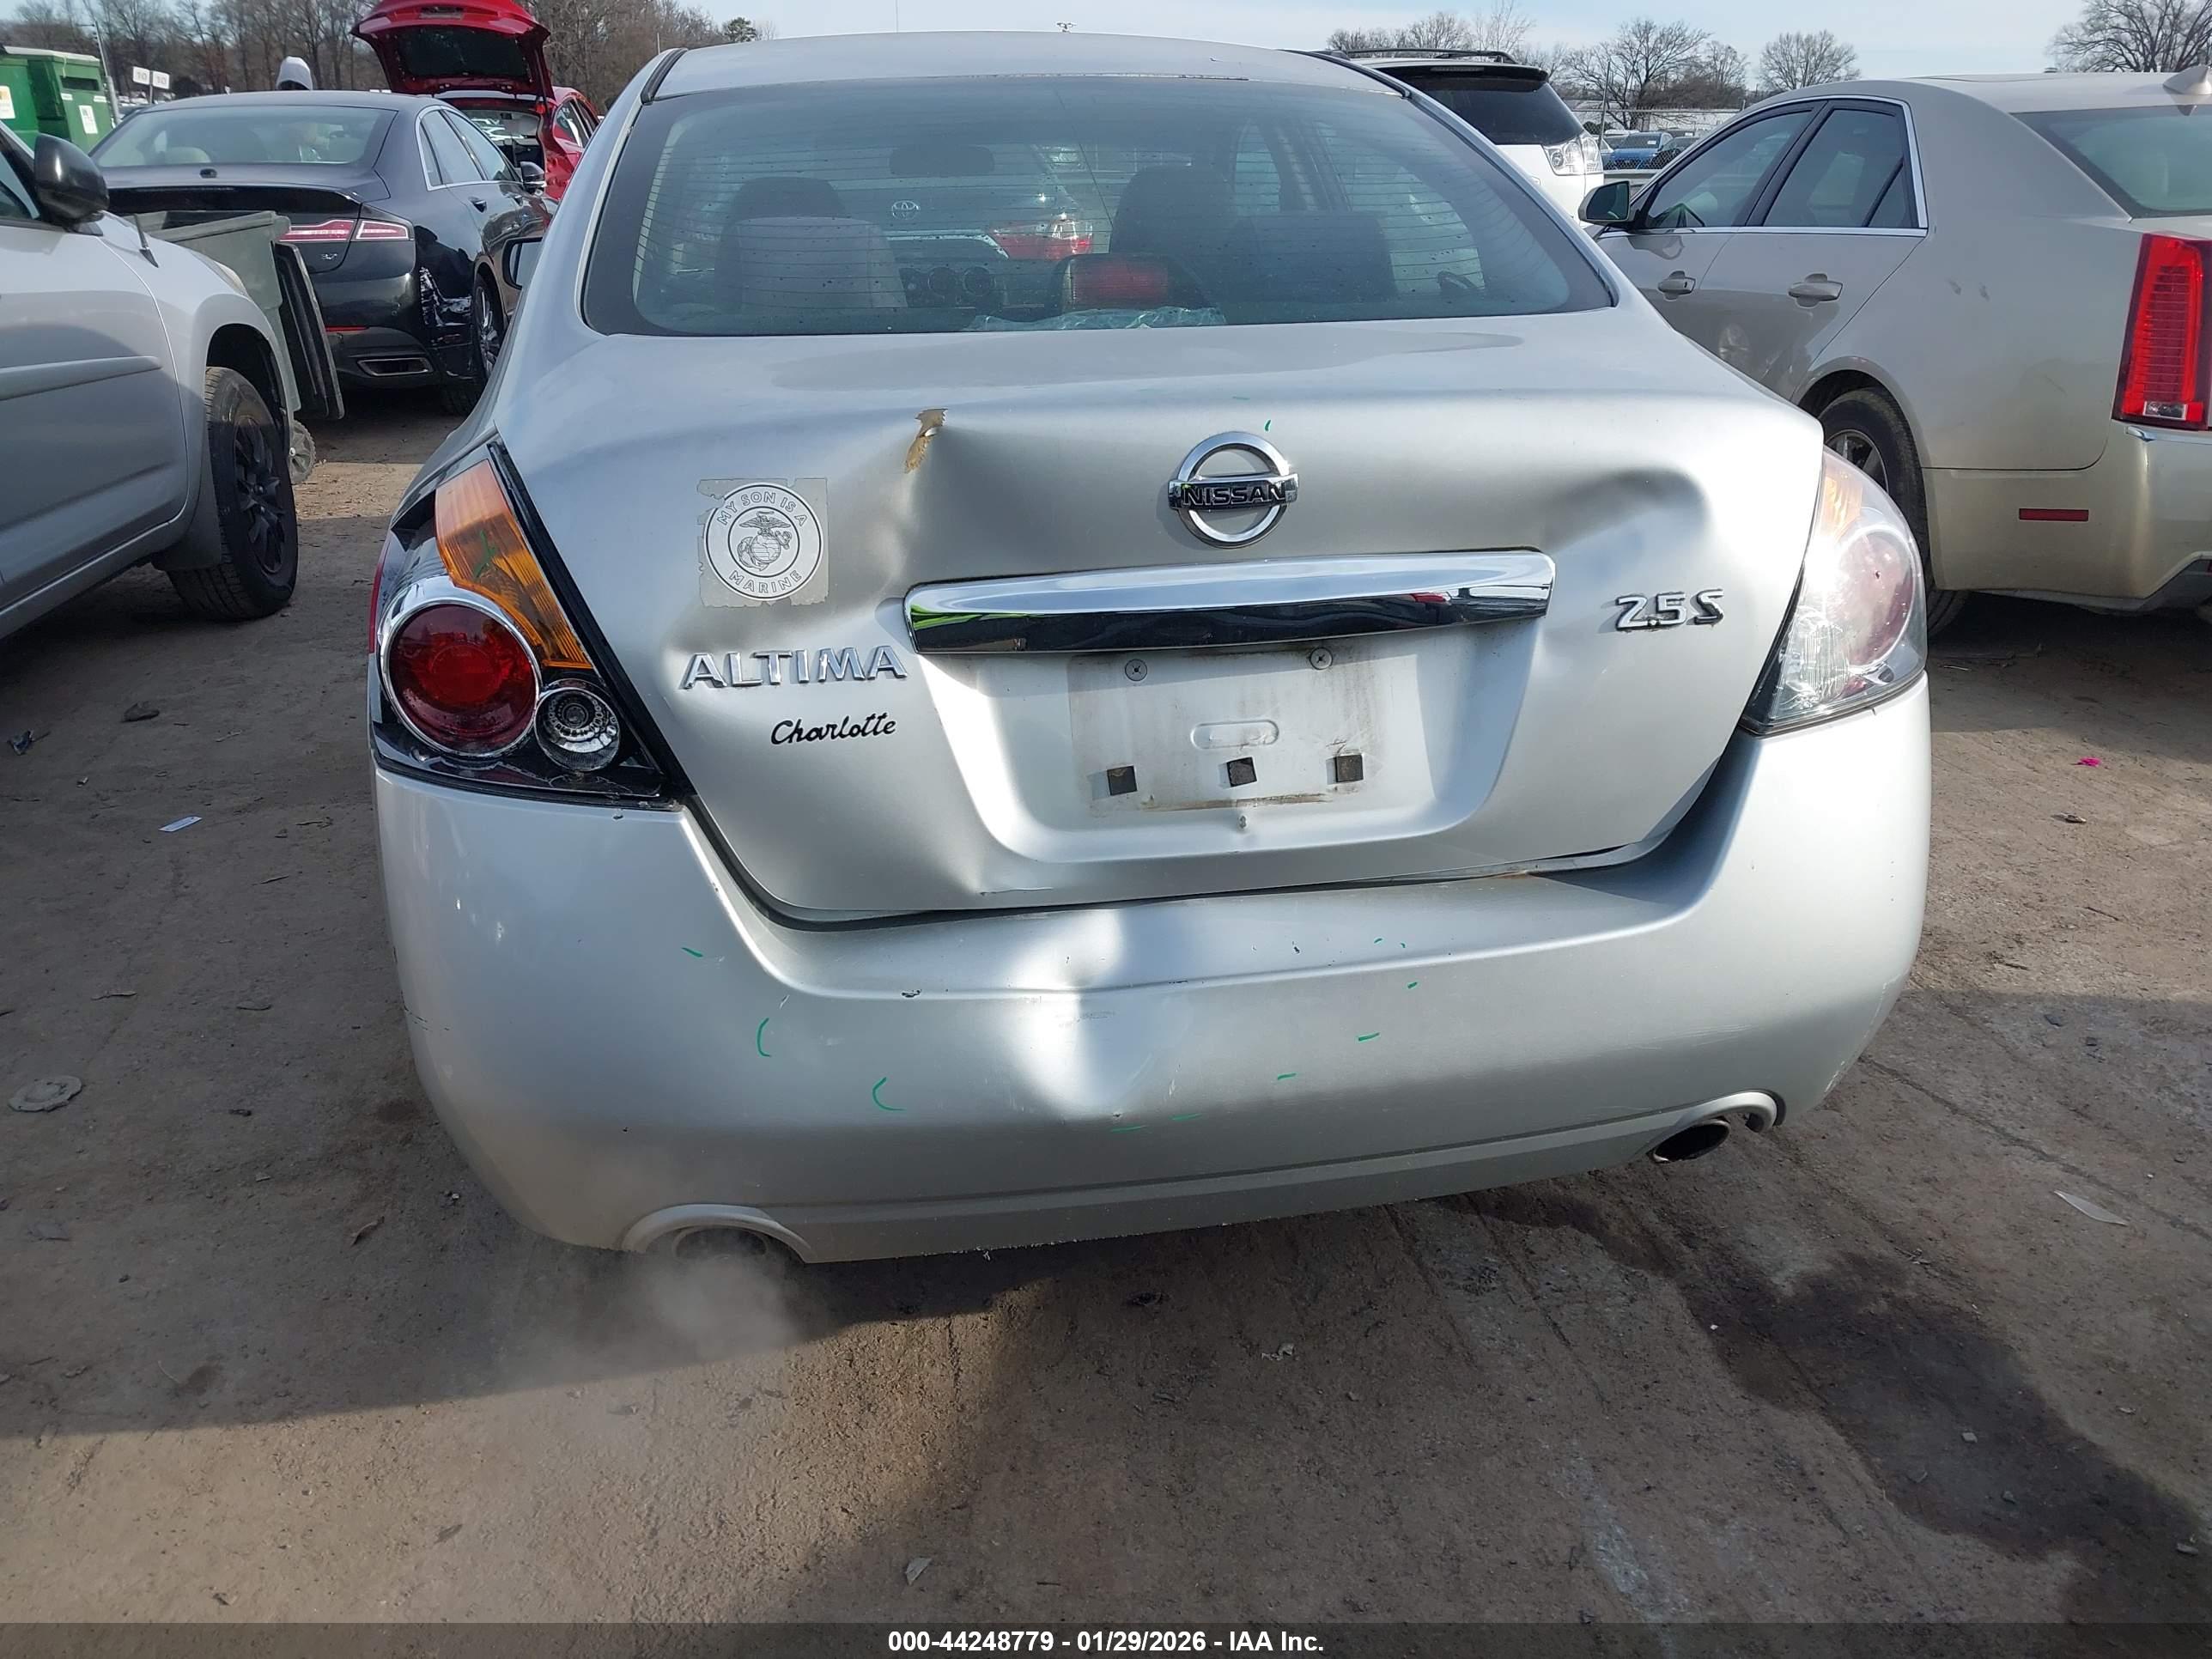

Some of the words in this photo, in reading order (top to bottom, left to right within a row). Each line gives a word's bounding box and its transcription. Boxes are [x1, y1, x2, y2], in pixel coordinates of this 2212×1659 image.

[716, 501, 738, 526] MY
[740, 491, 776, 507] SON
[780, 496, 797, 513] IS
[793, 514, 808, 527] A
[1181, 483, 1285, 506] NISSAN
[728, 569, 803, 594] MARINE
[683, 645, 908, 690] ALTIMA
[770, 712, 897, 745] Charlotte
